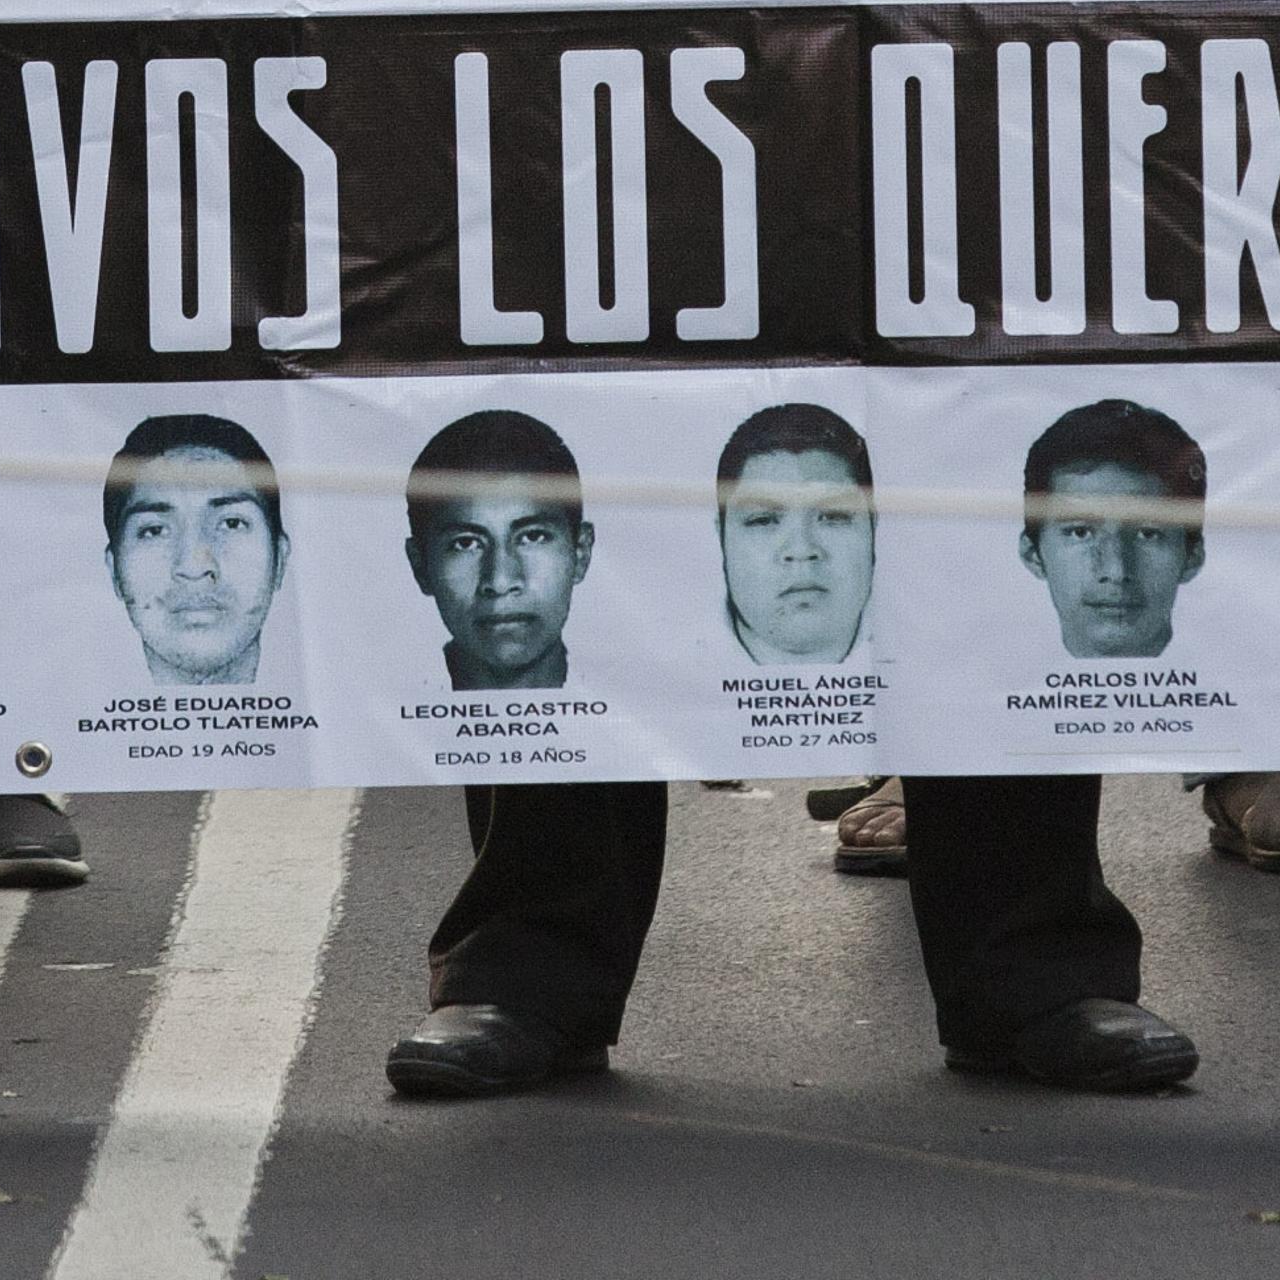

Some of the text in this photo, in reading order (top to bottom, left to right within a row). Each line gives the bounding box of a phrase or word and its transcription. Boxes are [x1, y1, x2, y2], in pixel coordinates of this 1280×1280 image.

[454, 46, 760, 347] LOS
[723, 675, 889, 693] MIGUEL ÁNGEL
[1046, 670, 1197, 689] CARLOS IVÁN
[104, 696, 292, 713] JOSÉ EDUARDO
[738, 693, 876, 710] HERNÁNDEZ
[1007, 692, 1238, 710] RAMÍREZ VILLAREAL
[401, 702, 608, 720] LEONEL CASTRO
[752, 711, 863, 727] MARTÍNEZ
[79, 716, 319, 733] BARTOLO TLATEMPA
[456, 722, 559, 738] ABARCA
